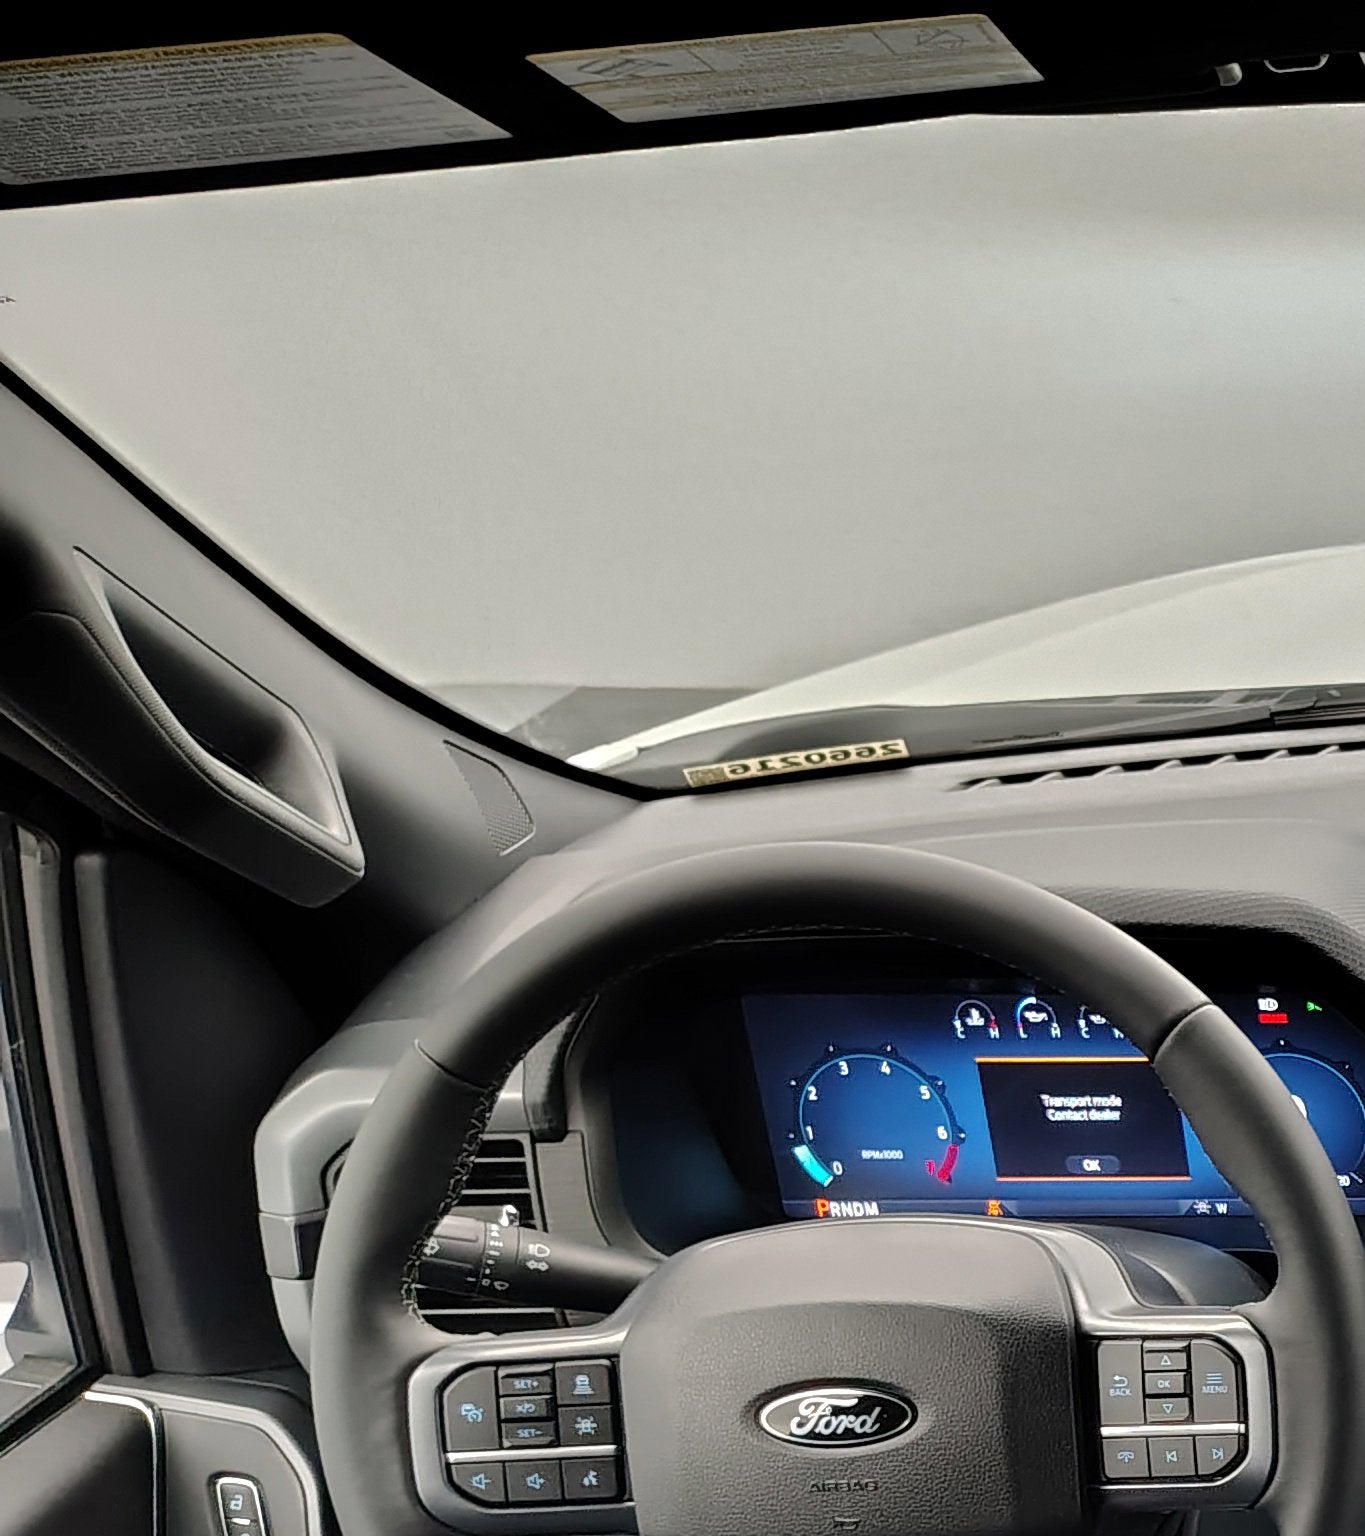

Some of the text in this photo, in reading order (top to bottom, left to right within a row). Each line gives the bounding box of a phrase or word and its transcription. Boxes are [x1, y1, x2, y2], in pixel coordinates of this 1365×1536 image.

[838, 1061, 849, 1076] 3
[880, 1061, 891, 1076] 4
[807, 1085, 818, 1101] 2
[920, 1085, 931, 1100] 5
[805, 1126, 814, 1140] 1
[937, 1126, 948, 1140] 6
[832, 1160, 843, 1176] 0
[1083, 1159, 1101, 1171] OK
[1157, 1380, 1171, 1389] OK
[1202, 1385, 1228, 1394] MENU
[1109, 1388, 1131, 1397] BACK
[790, 1397, 882, 1436] Ford
